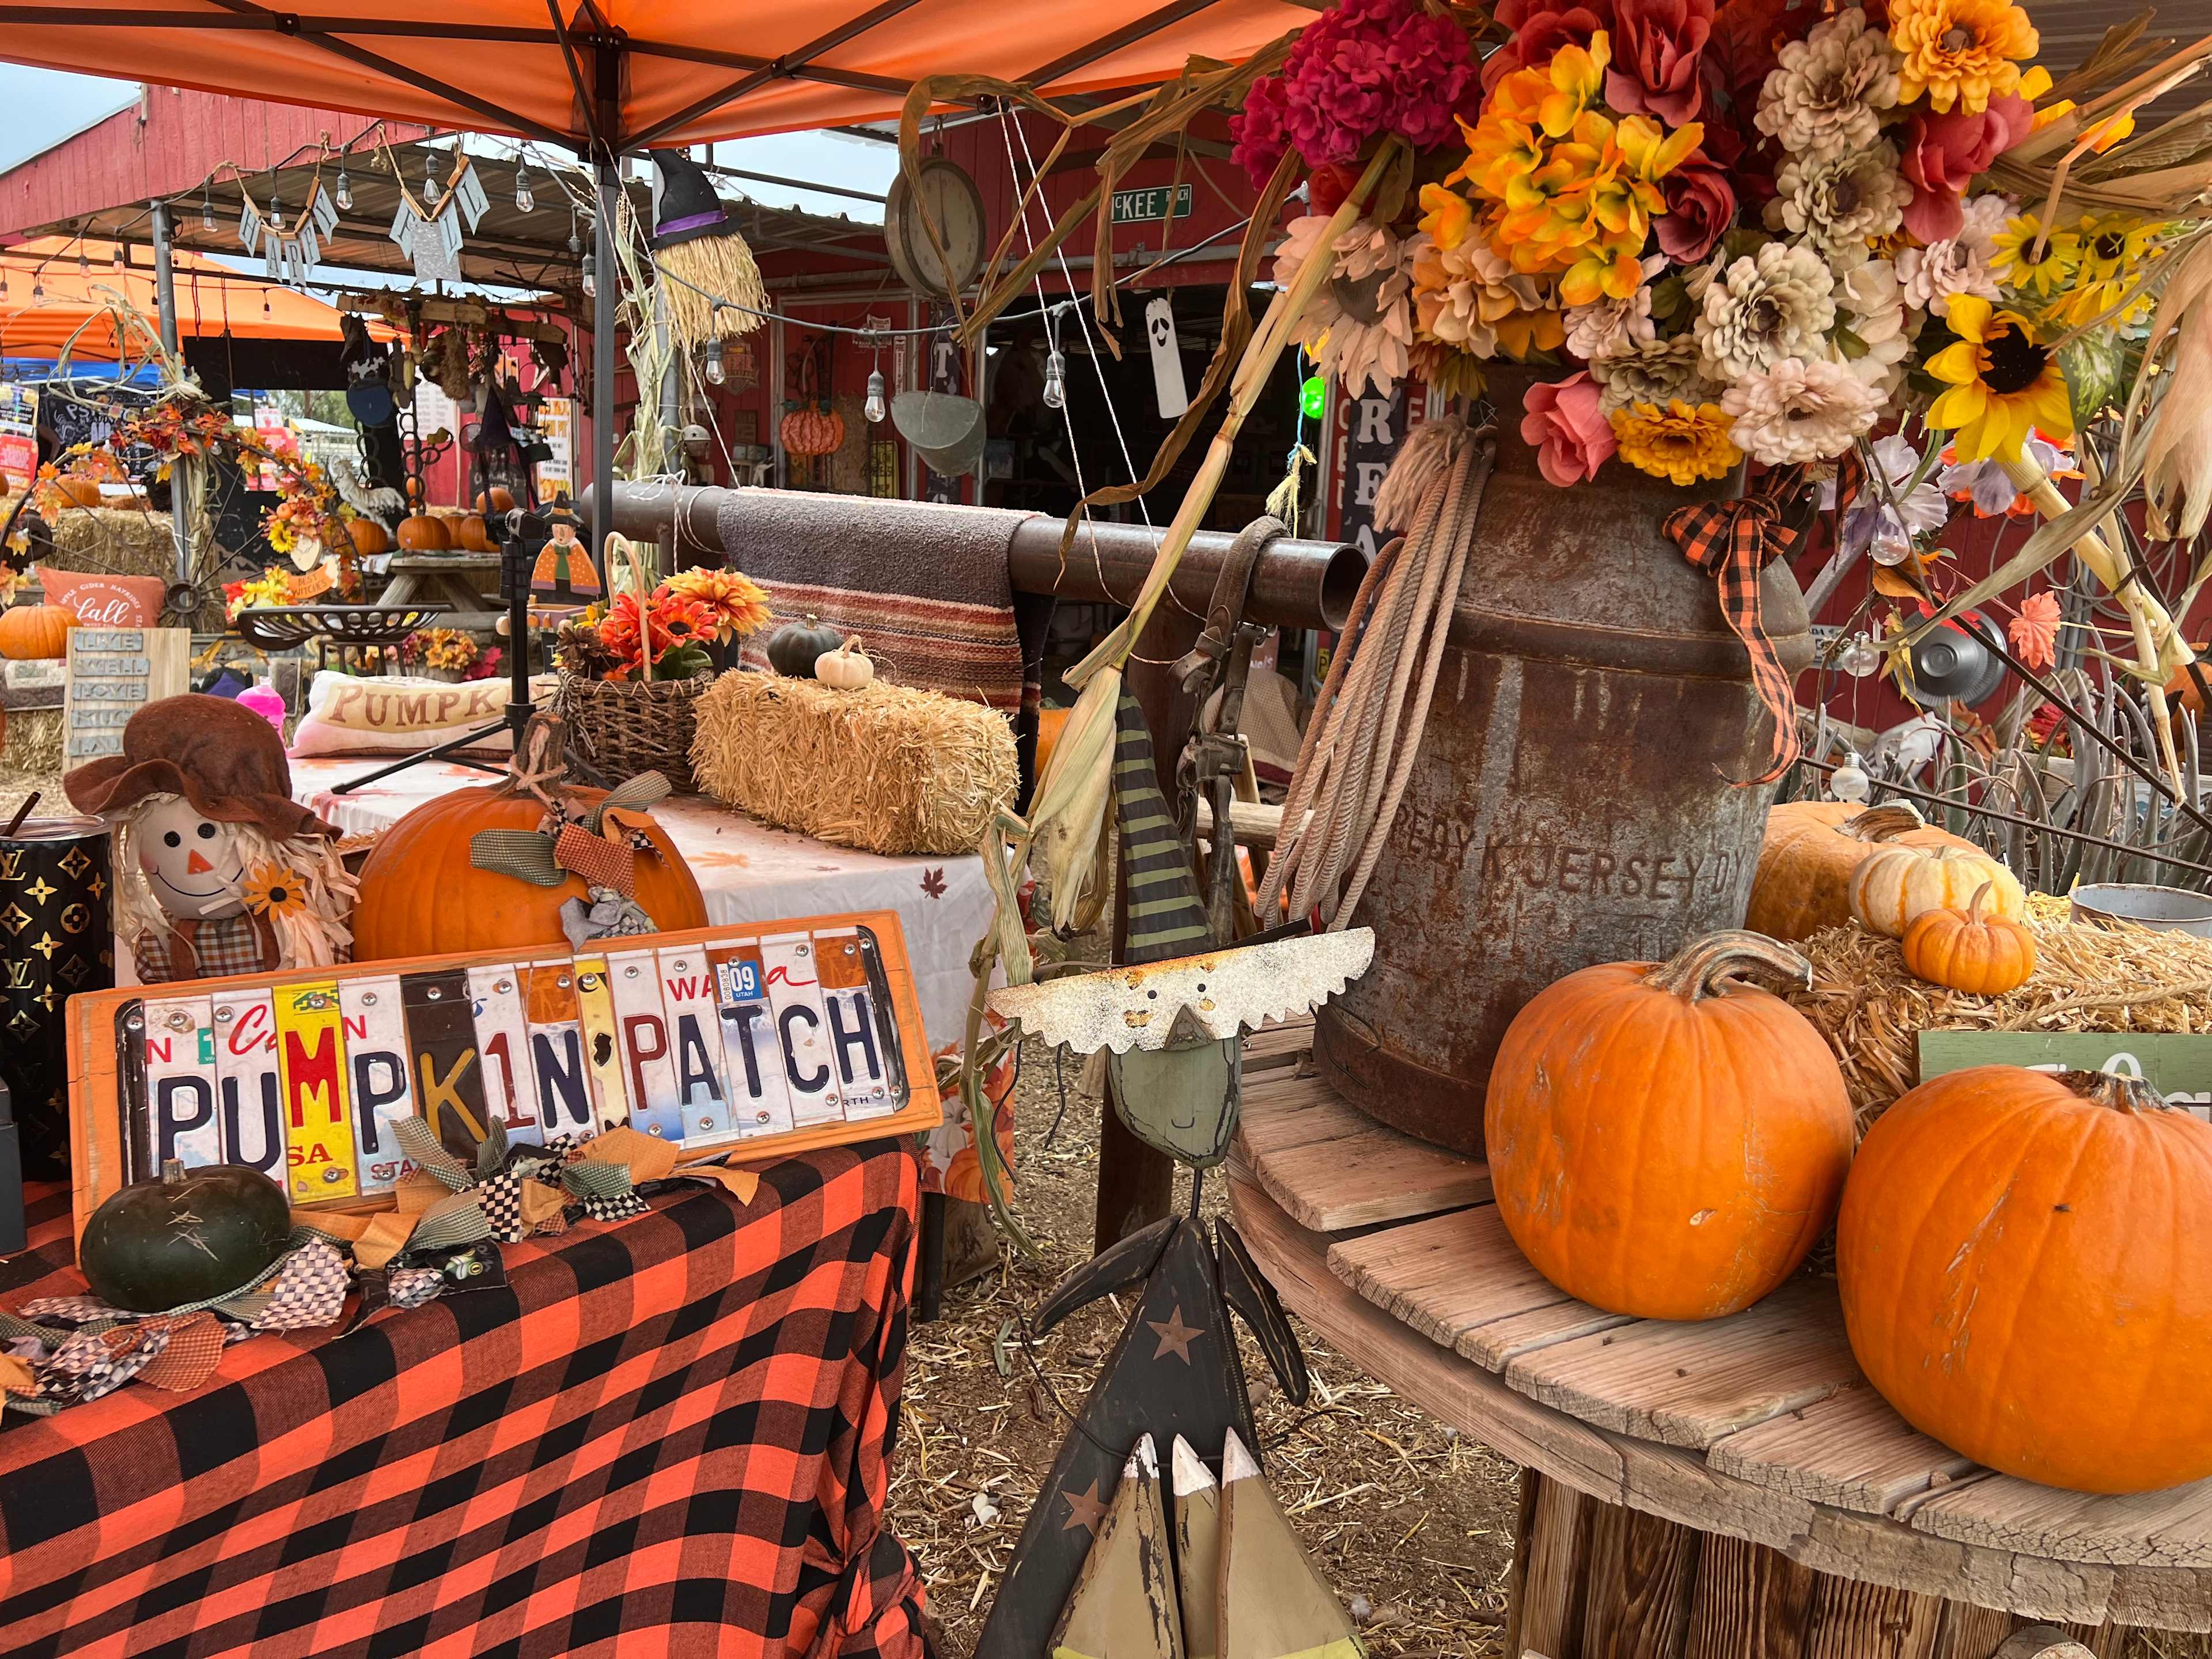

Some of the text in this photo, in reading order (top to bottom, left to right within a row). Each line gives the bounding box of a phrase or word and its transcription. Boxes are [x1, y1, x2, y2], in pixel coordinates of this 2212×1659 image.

[1112, 188, 1188, 219] cKEE RCH
[397, 181, 482, 252] FLL
[242, 192, 332, 277] HAPPY
[79, 582, 105, 590] CIDER
[293, 579, 328, 596] WITCHES
[298, 574, 317, 586] BEST
[83, 634, 135, 648] LIVE
[81, 659, 143, 673] WELL
[79, 684, 139, 698] LOVE
[78, 711, 131, 725] MUC
[1524, 844, 1705, 907] JERSEY
[730, 966, 755, 992] 09
[623, 993, 880, 1110] PATCH
